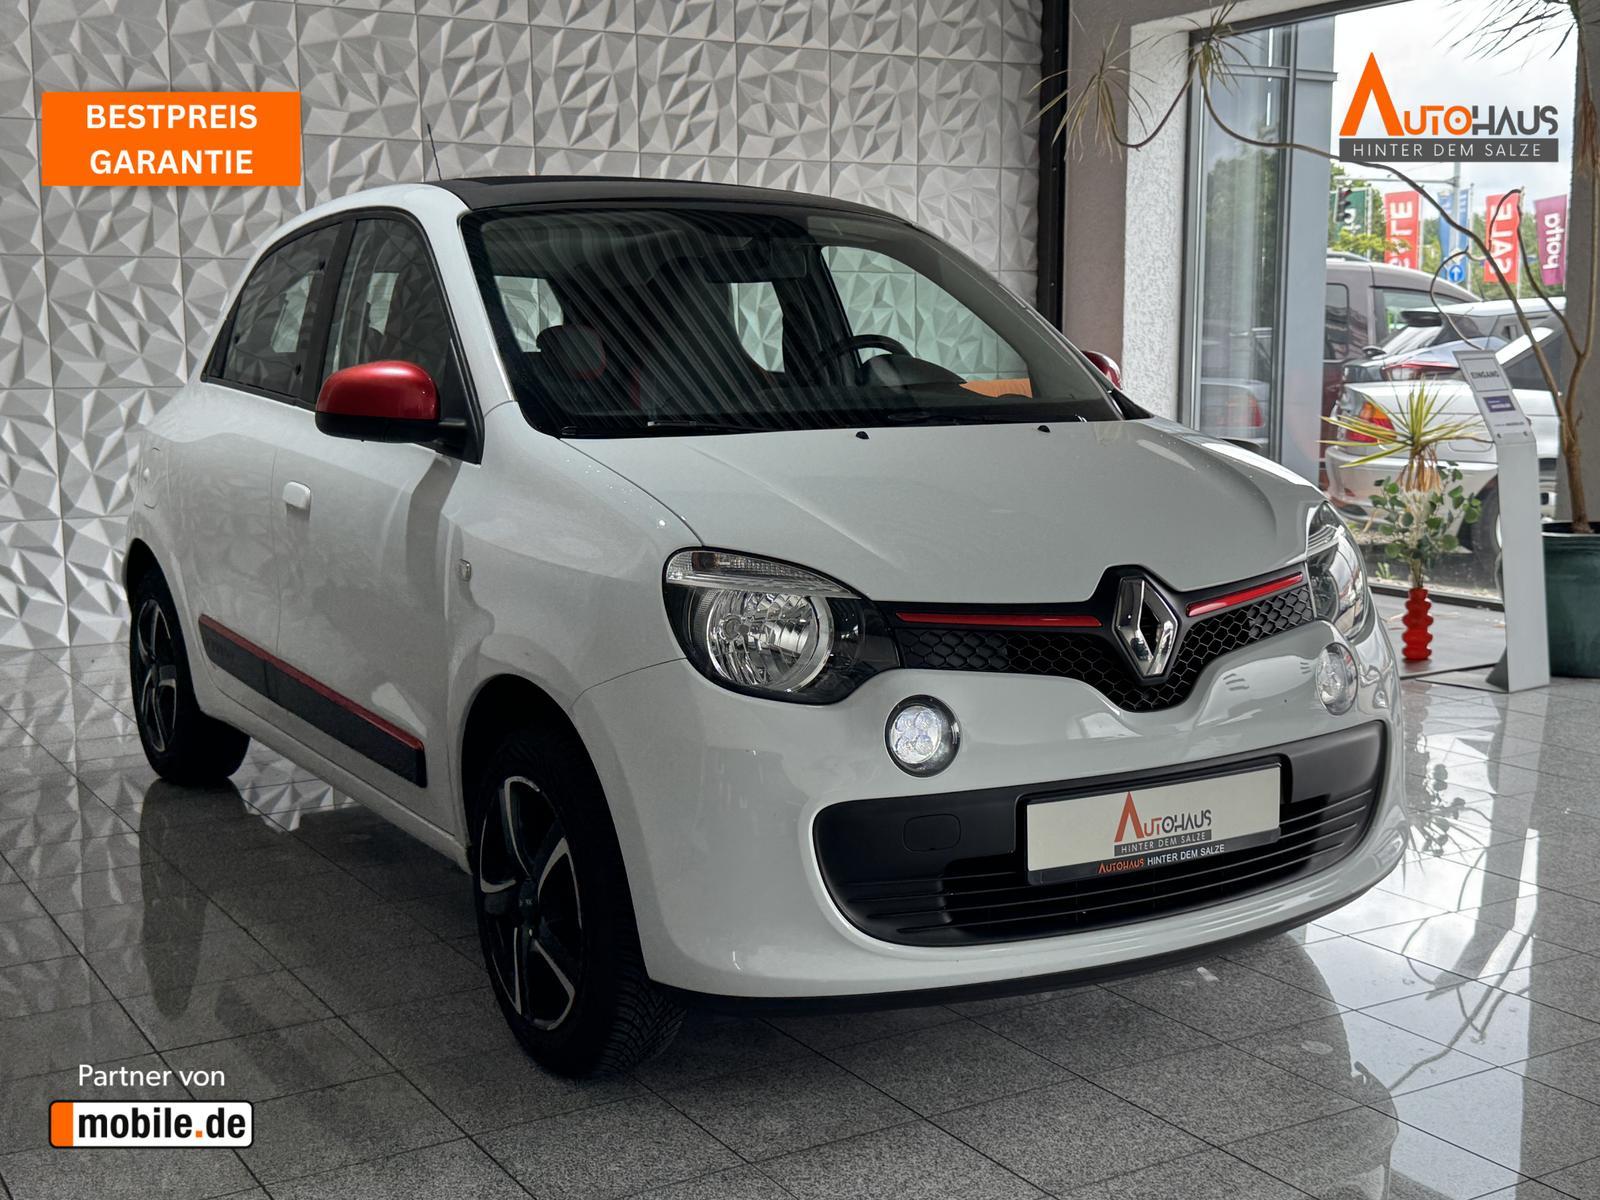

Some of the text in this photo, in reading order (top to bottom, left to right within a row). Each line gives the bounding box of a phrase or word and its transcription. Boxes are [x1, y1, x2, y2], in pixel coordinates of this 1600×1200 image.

[1114, 791, 1212, 842] AUTOHAUS
[1120, 832, 1207, 853] HINTER DEM SALZE
[1098, 844, 1225, 874] AUTOHAUS HINTER DEM SALZE
